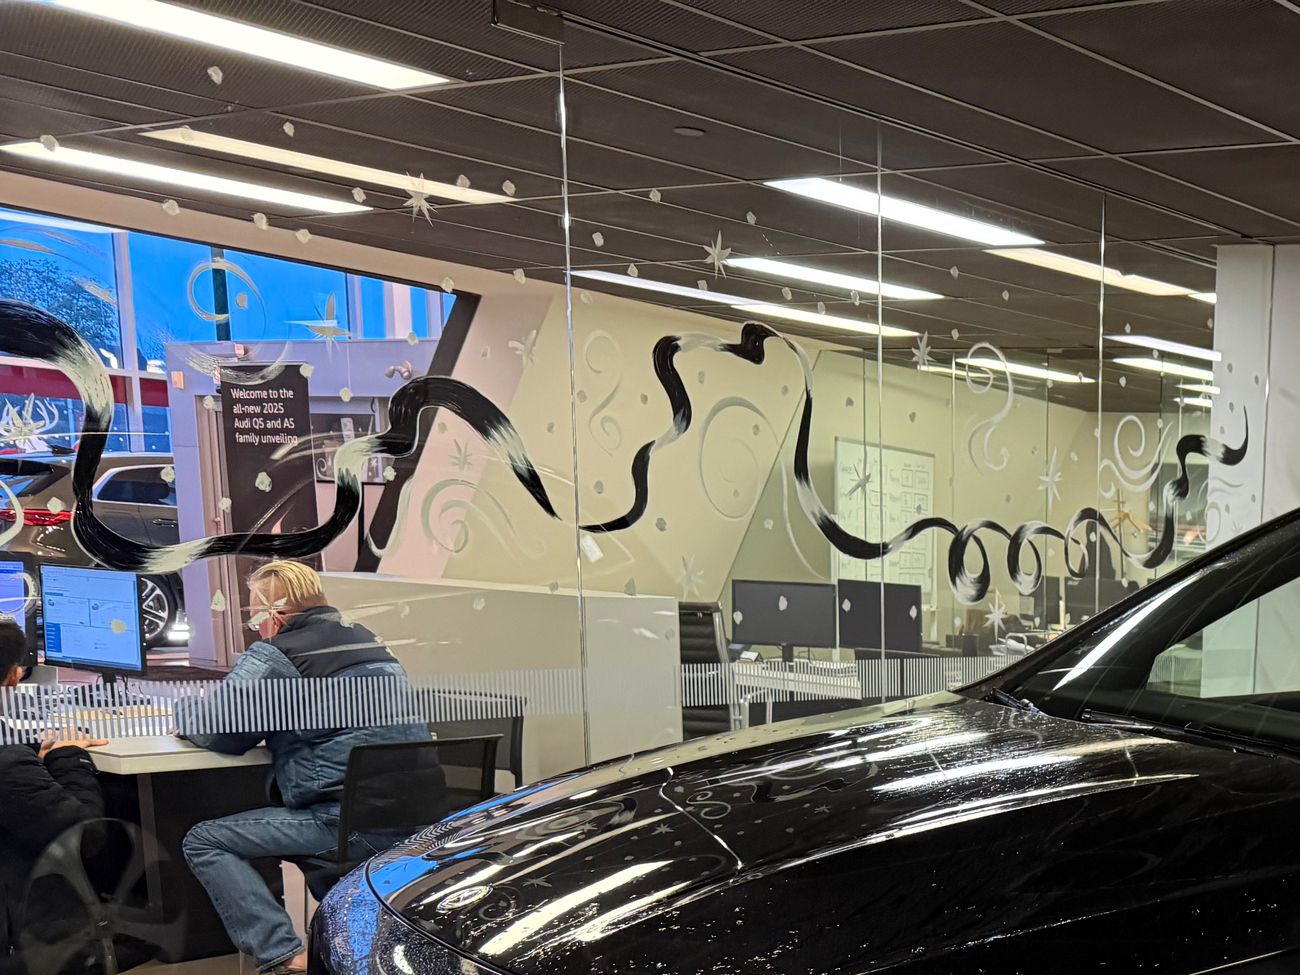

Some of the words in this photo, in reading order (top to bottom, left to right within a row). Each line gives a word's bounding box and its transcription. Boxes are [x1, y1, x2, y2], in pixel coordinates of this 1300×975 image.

[231, 388, 268, 399] Welcome
[269, 389, 278, 399] to
[279, 387, 294, 399] the
[232, 403, 261, 414] all-new
[262, 403, 285, 414] 2025
[234, 418, 251, 429] Audi
[252, 418, 265, 430] Q5
[266, 418, 281, 429] and
[283, 418, 295, 429] A5
[235, 432, 260, 446] family
[261, 433, 298, 446] unveiling
